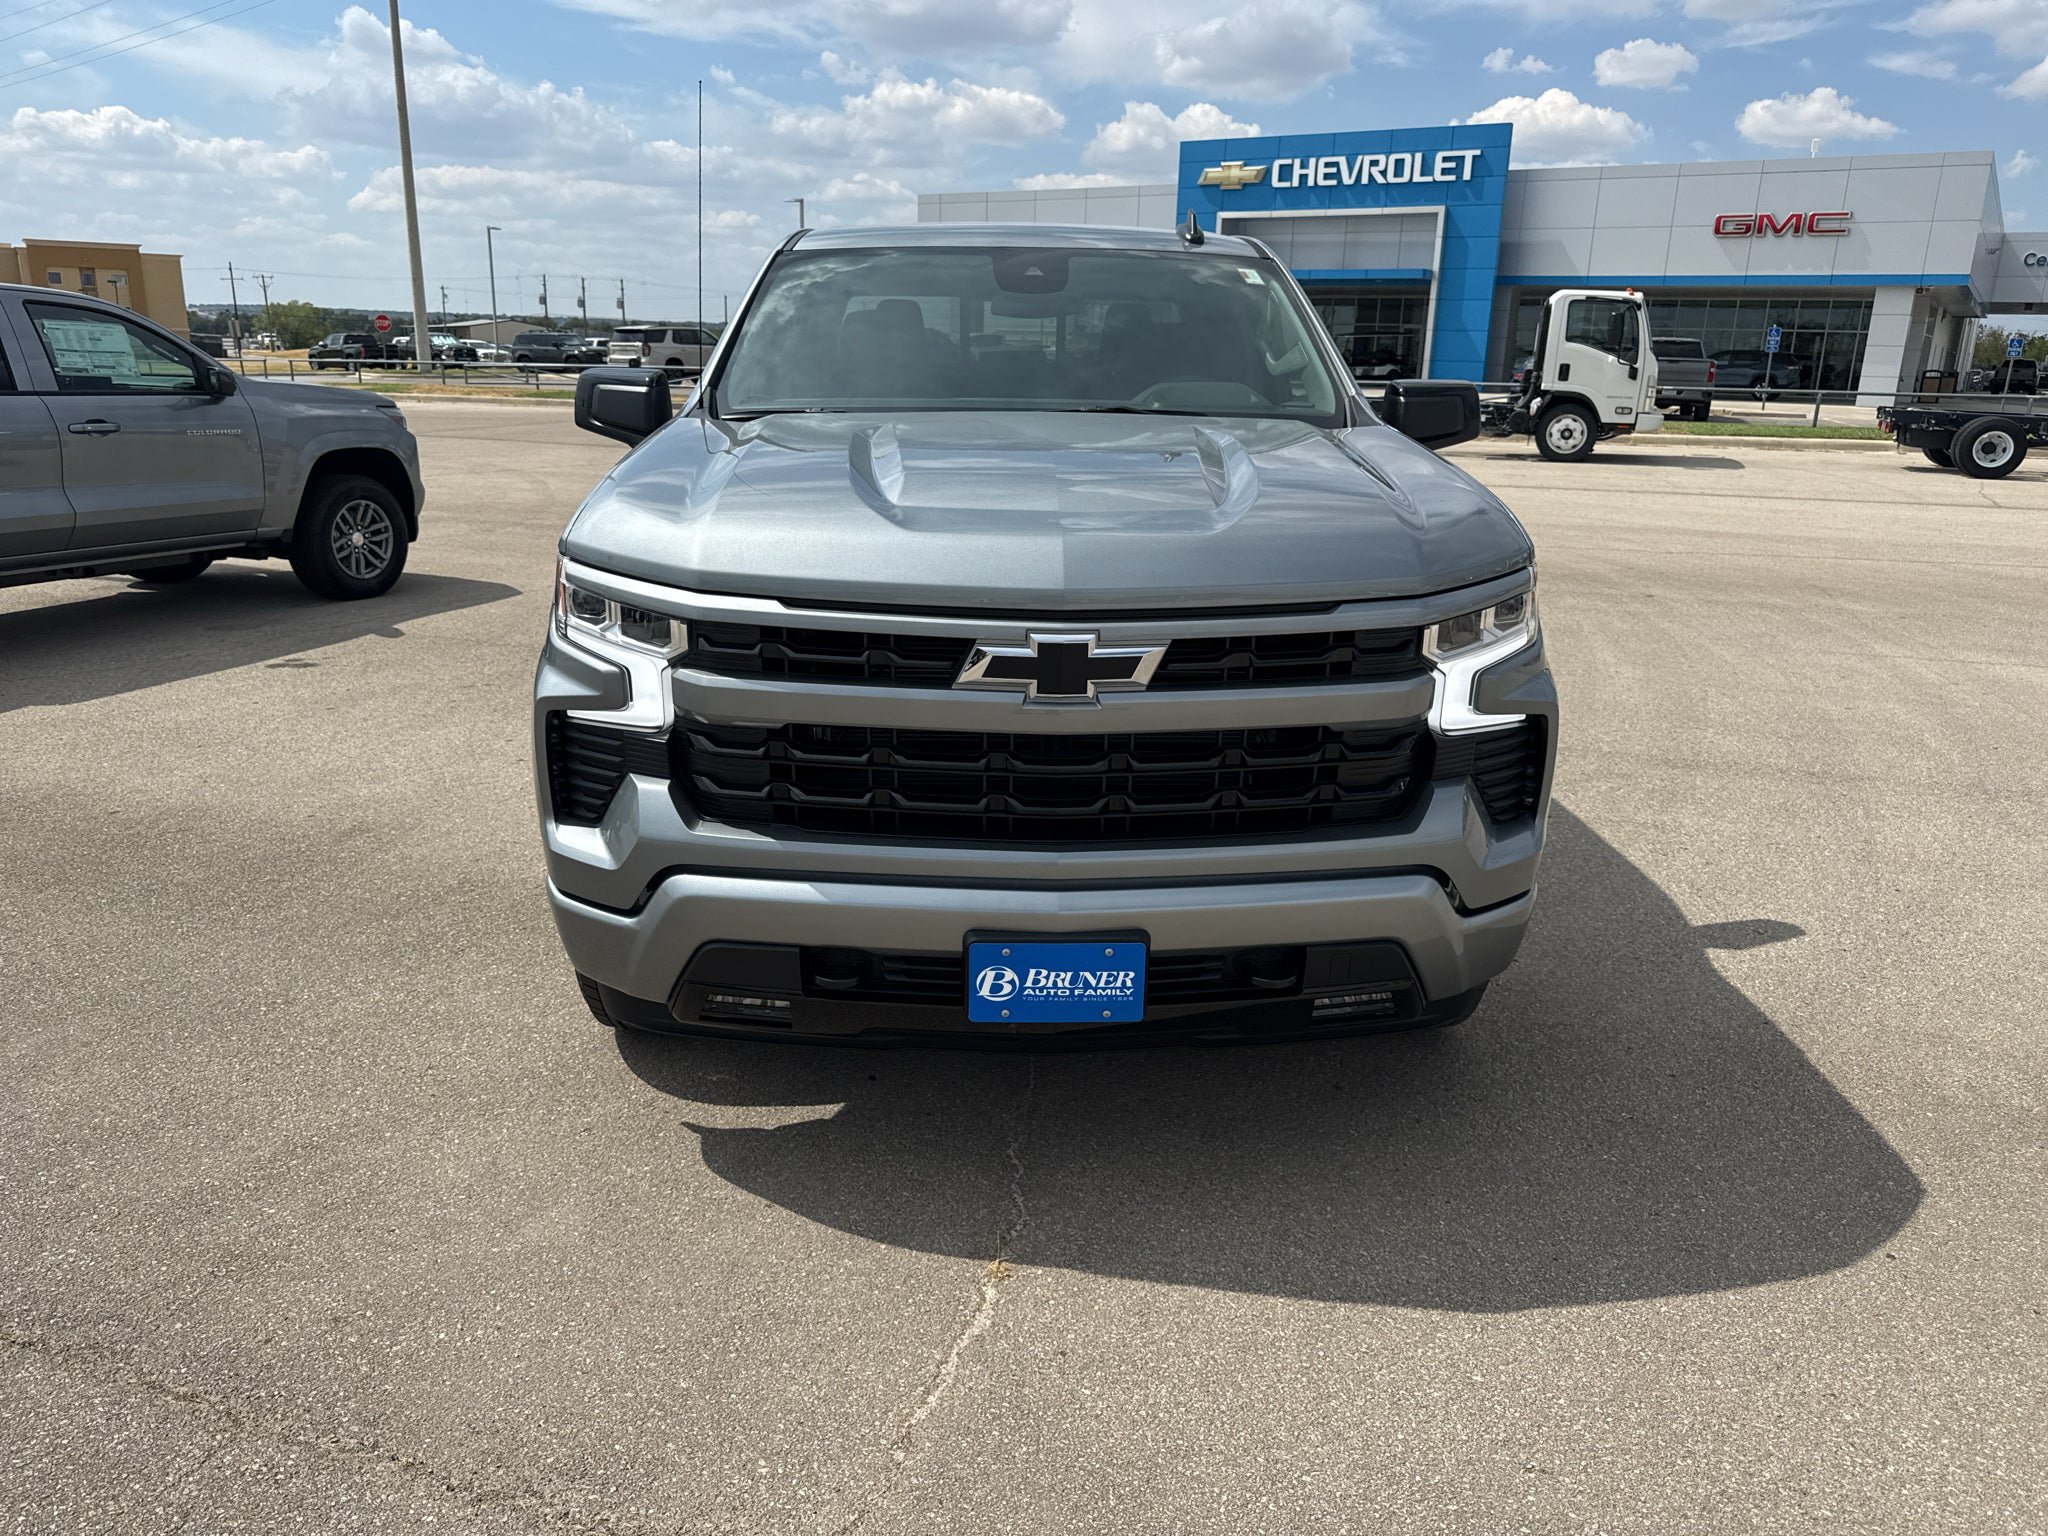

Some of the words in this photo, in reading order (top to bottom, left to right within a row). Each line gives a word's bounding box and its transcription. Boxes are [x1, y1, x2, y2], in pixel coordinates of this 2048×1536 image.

[1271, 149, 1481, 188] CHEVROLET
[1713, 211, 1852, 238] GMC
[2023, 252, 2048, 267] Ce
[1023, 968, 1135, 988] BRUNER
[1023, 988, 1070, 996] AUTO
[1074, 988, 1135, 996] FAMILY
